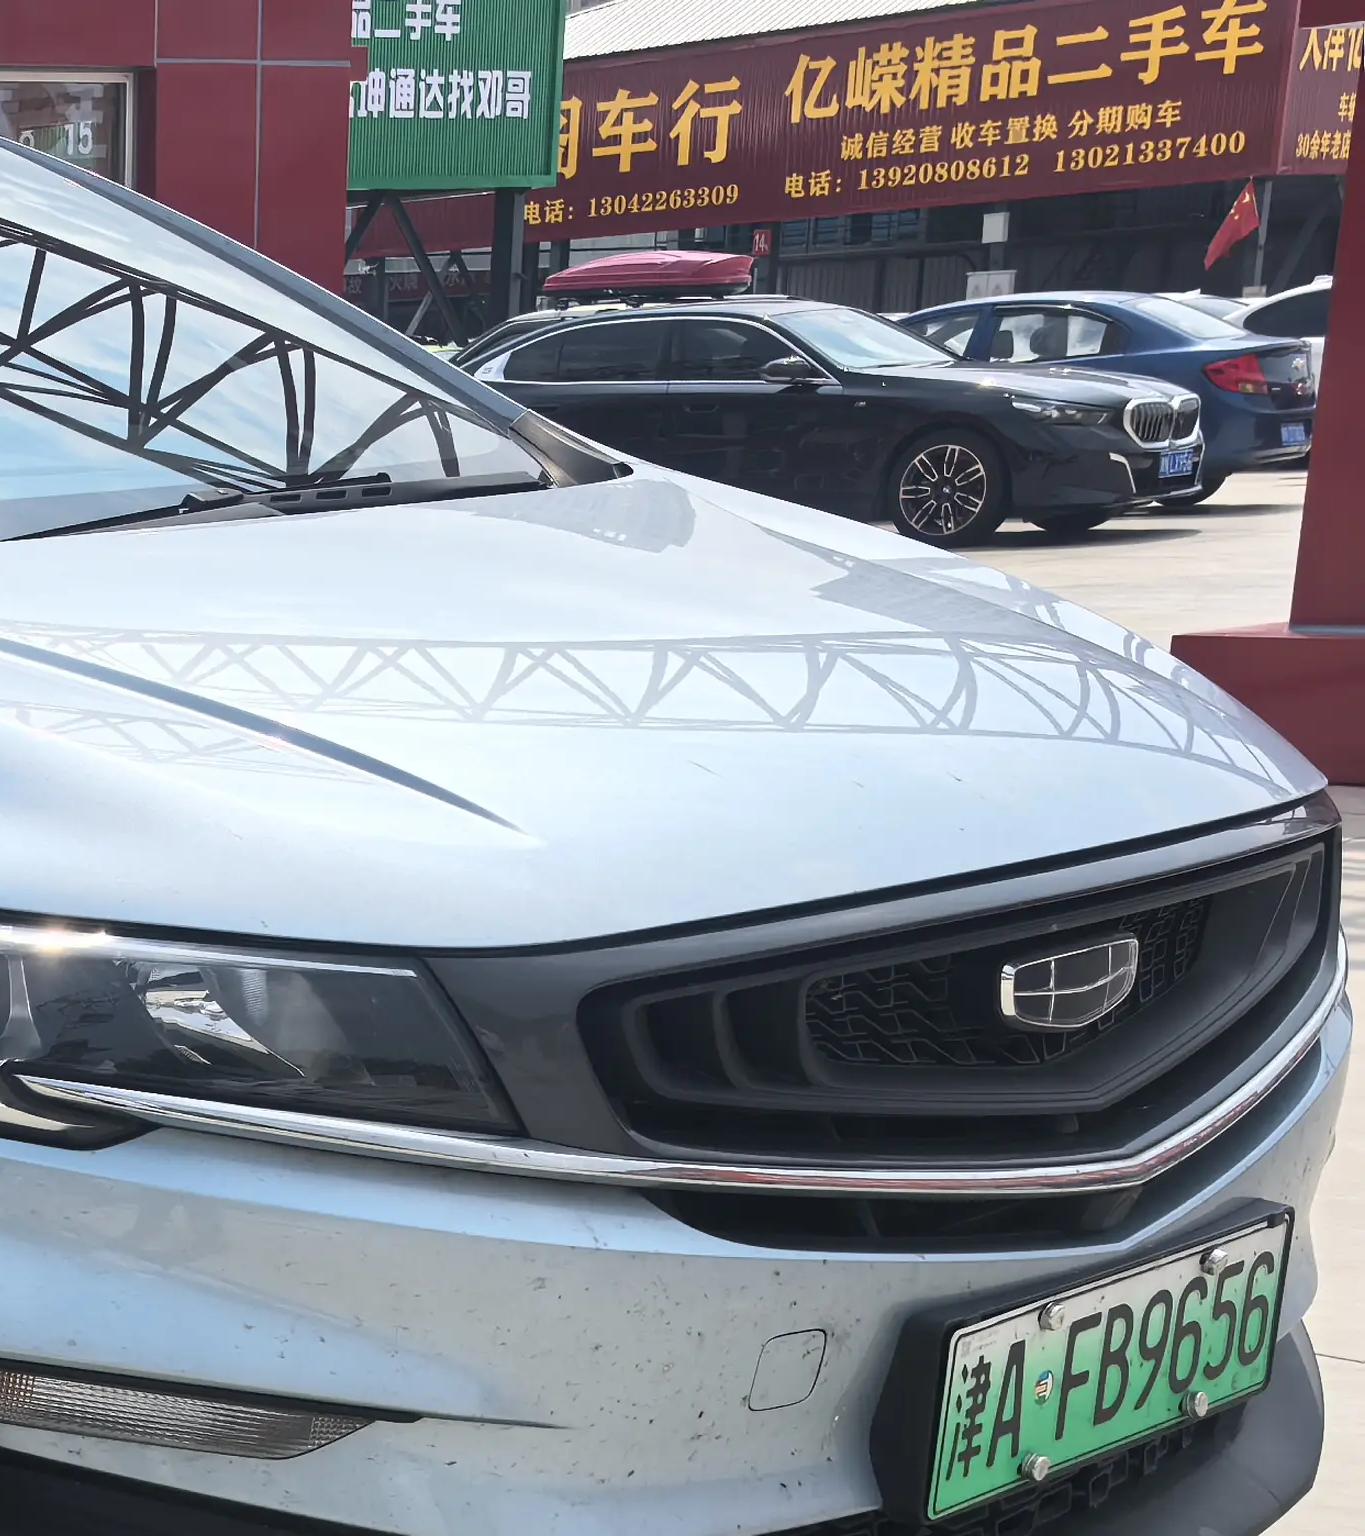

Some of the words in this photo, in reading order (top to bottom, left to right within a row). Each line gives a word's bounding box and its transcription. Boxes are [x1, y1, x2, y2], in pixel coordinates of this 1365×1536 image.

[785, 0, 1267, 124] 亿嵘精品二手车
[349, 68, 532, 119] 坤通达找邓哥
[841, 125, 943, 161] 诚信经营
[950, 113, 1058, 147] 收车置换
[1068, 100, 1183, 138] 分期购车
[857, 153, 1030, 191] 13920808612
[1054, 131, 1246, 173] 13021337400
[588, 184, 740, 217] 13042263309
